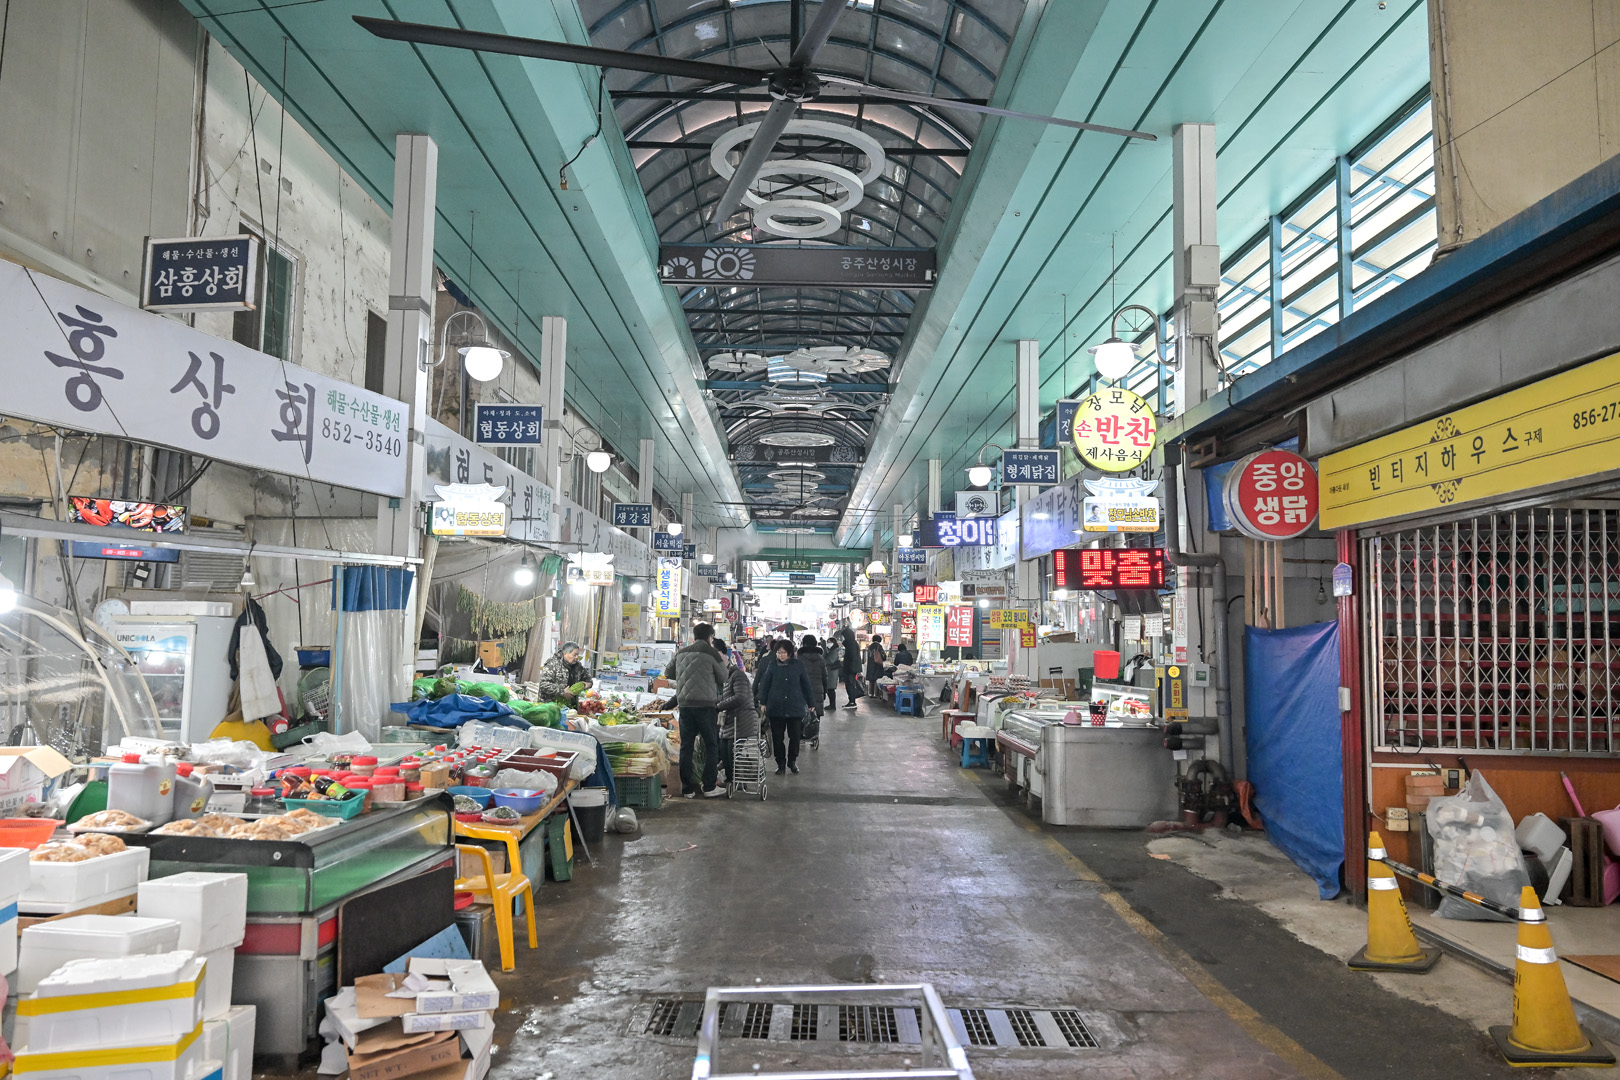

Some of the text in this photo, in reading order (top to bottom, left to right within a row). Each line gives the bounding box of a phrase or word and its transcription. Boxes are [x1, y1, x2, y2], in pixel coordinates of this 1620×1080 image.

[162, 247, 239, 260] 해물·수산물·생선
[841, 256, 917, 271] 공주산성시장
[155, 265, 244, 298] 삼흥상회
[327, 389, 400, 433] 해물·수산물·생선
[1086, 390, 1147, 414] 장모님
[322, 417, 401, 458] 852-3540
[480, 420, 540, 440] 협동상회
[1075, 415, 1156, 447] 손반찬
[1085, 446, 1142, 463] 제사음식
[1369, 424, 1543, 491] 빈티지하우스 구제
[1006, 463, 1056, 480] 형제닭집
[1252, 462, 1306, 491] 중앙
[616, 511, 651, 524] 생강집
[1108, 508, 1157, 522] 장모님손반찬
[1253, 495, 1308, 525] 생닭
[456, 512, 504, 527] 협동상회
[949, 609, 972, 626] 사골
[1003, 611, 1013, 622] 오리
[948, 628, 971, 645] 떡국
[1173, 682, 1181, 704] 소화기
